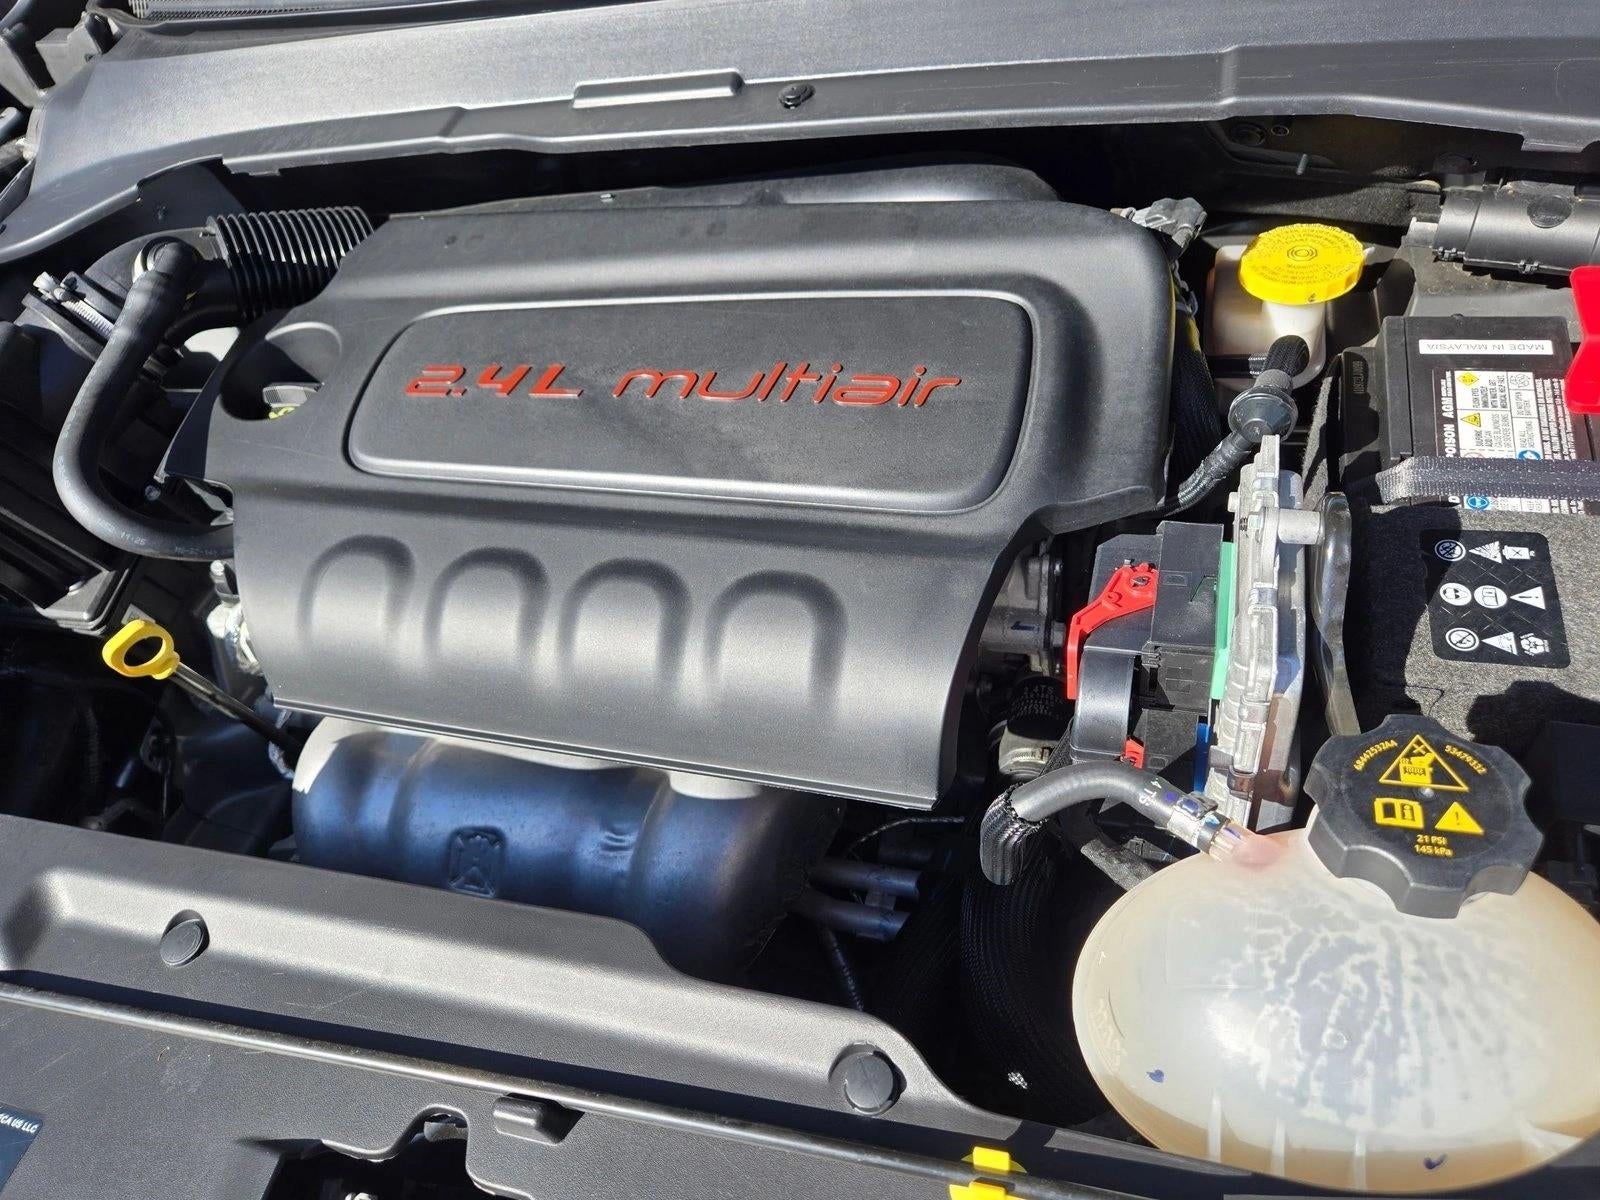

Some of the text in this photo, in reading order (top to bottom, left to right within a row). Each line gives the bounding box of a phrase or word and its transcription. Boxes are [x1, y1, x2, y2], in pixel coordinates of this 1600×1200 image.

[1426, 343, 1545, 351] MADE IN MALAYSIA
[406, 360, 962, 408] 2.4L multiair
[1440, 397, 1455, 419] AGM
[1416, 834, 1448, 846] 21 PSI
[1414, 844, 1454, 858] 145 kPa
